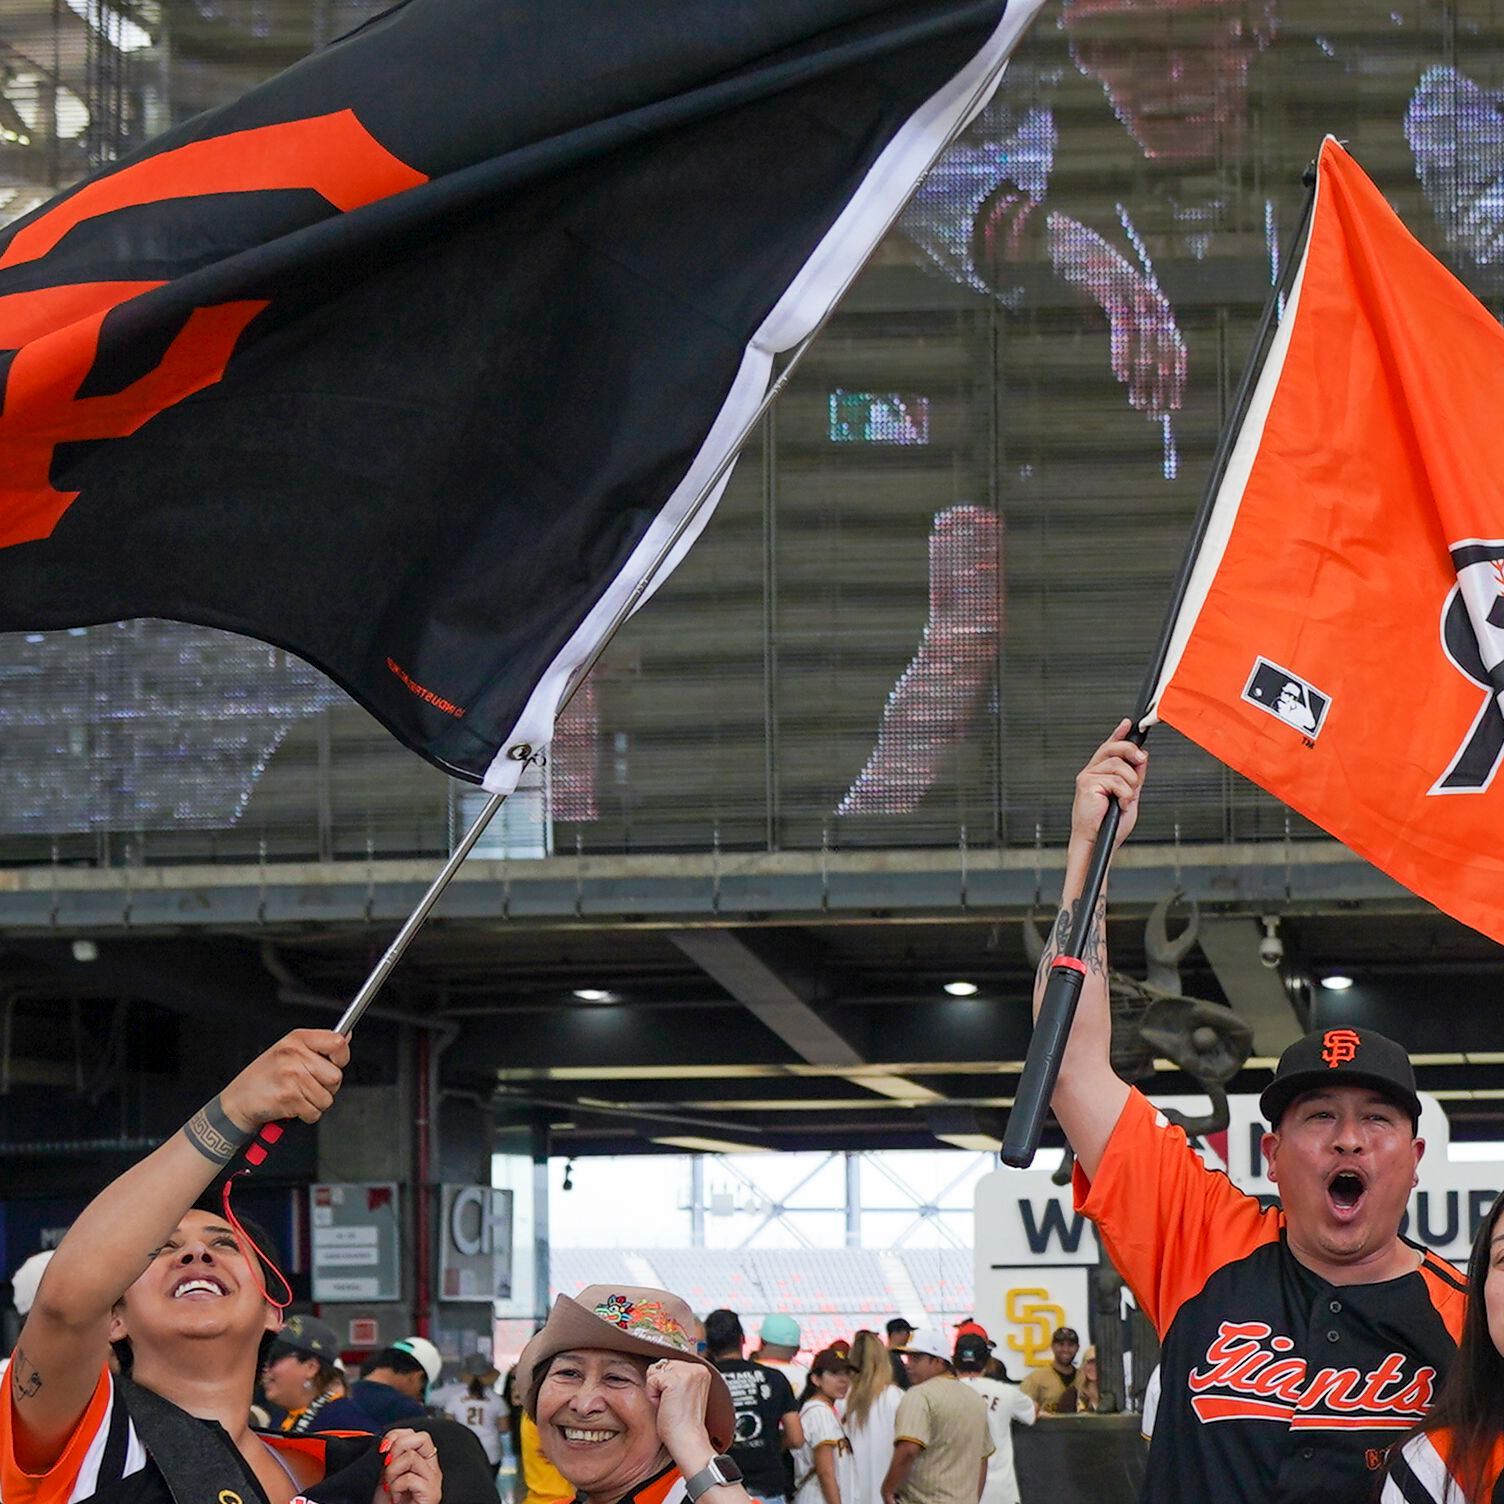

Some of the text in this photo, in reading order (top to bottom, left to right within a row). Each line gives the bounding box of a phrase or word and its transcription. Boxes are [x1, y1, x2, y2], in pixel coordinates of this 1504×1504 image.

[1321, 1029, 1361, 1069] SF
[1006, 1288, 1064, 1367] SD
[1188, 1320, 1437, 1416] Giants
[467, 1406, 484, 1426] 21
